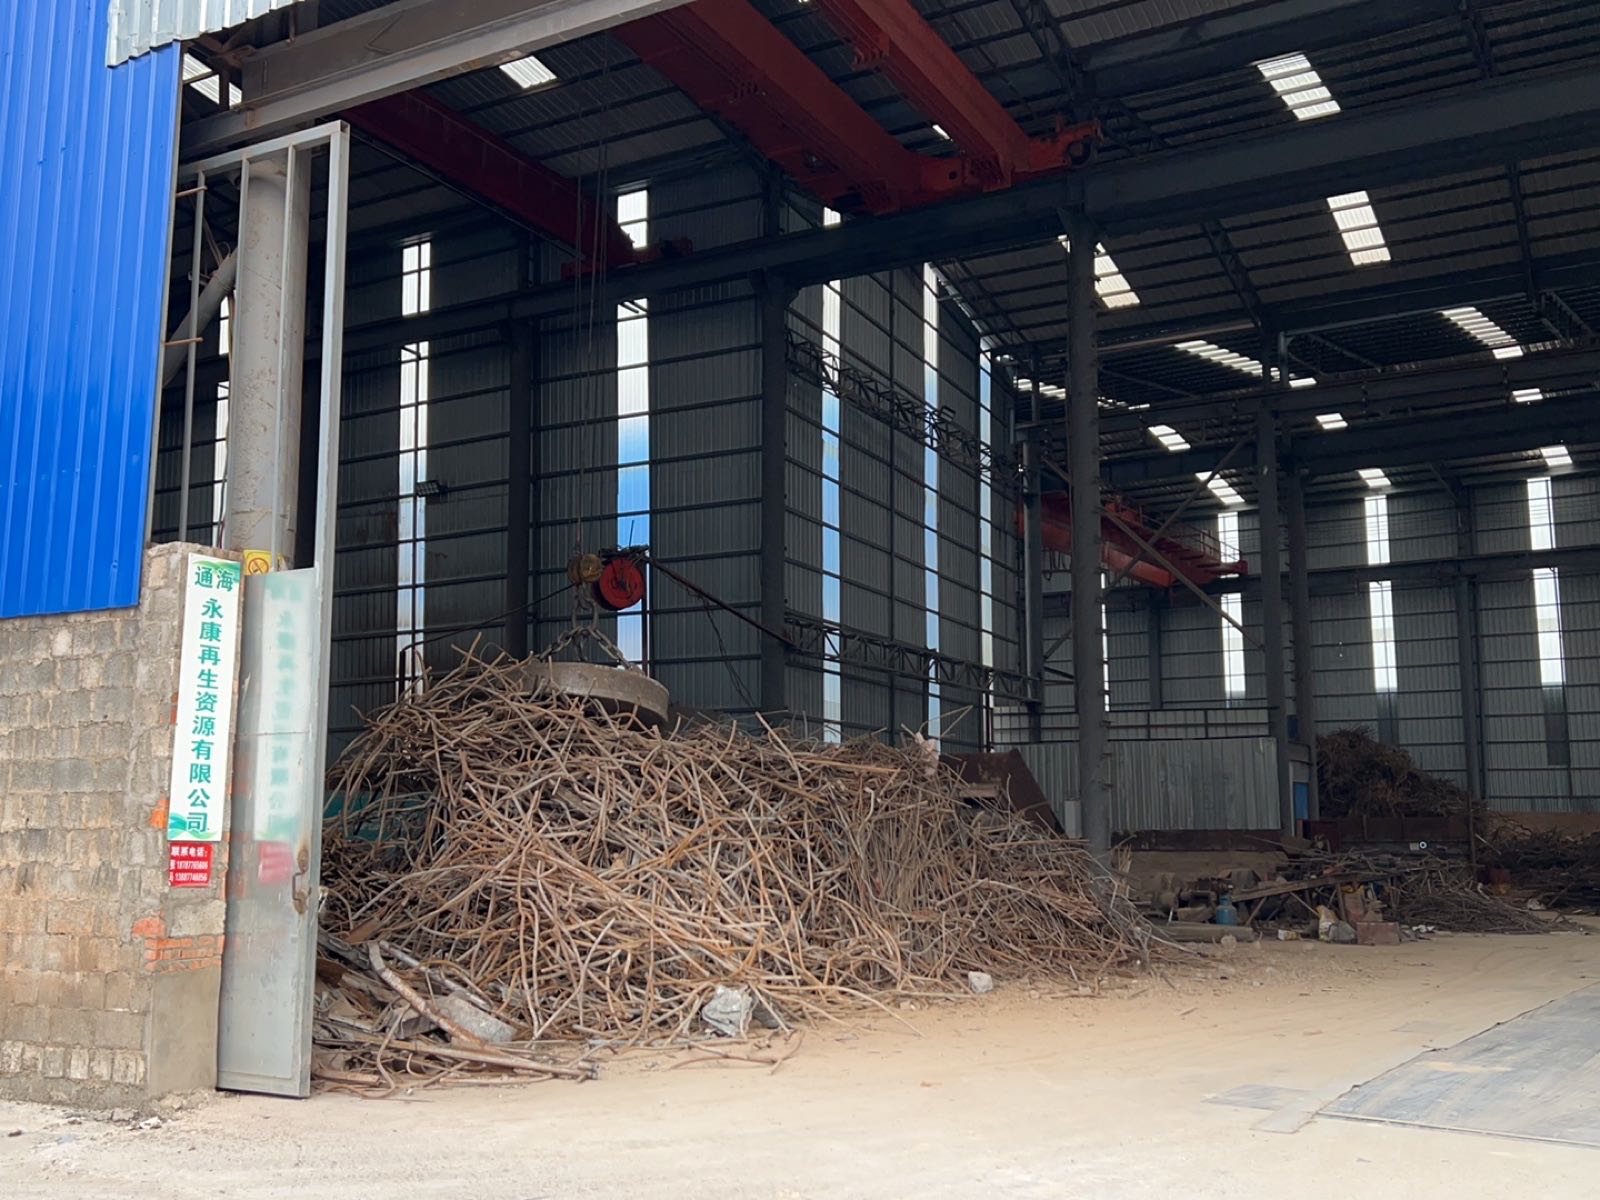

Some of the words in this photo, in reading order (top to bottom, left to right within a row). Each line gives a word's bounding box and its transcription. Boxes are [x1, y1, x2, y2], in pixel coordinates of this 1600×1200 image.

[194, 566, 234, 592] 通海
[186, 597, 224, 833] 永康再生资源有限公司
